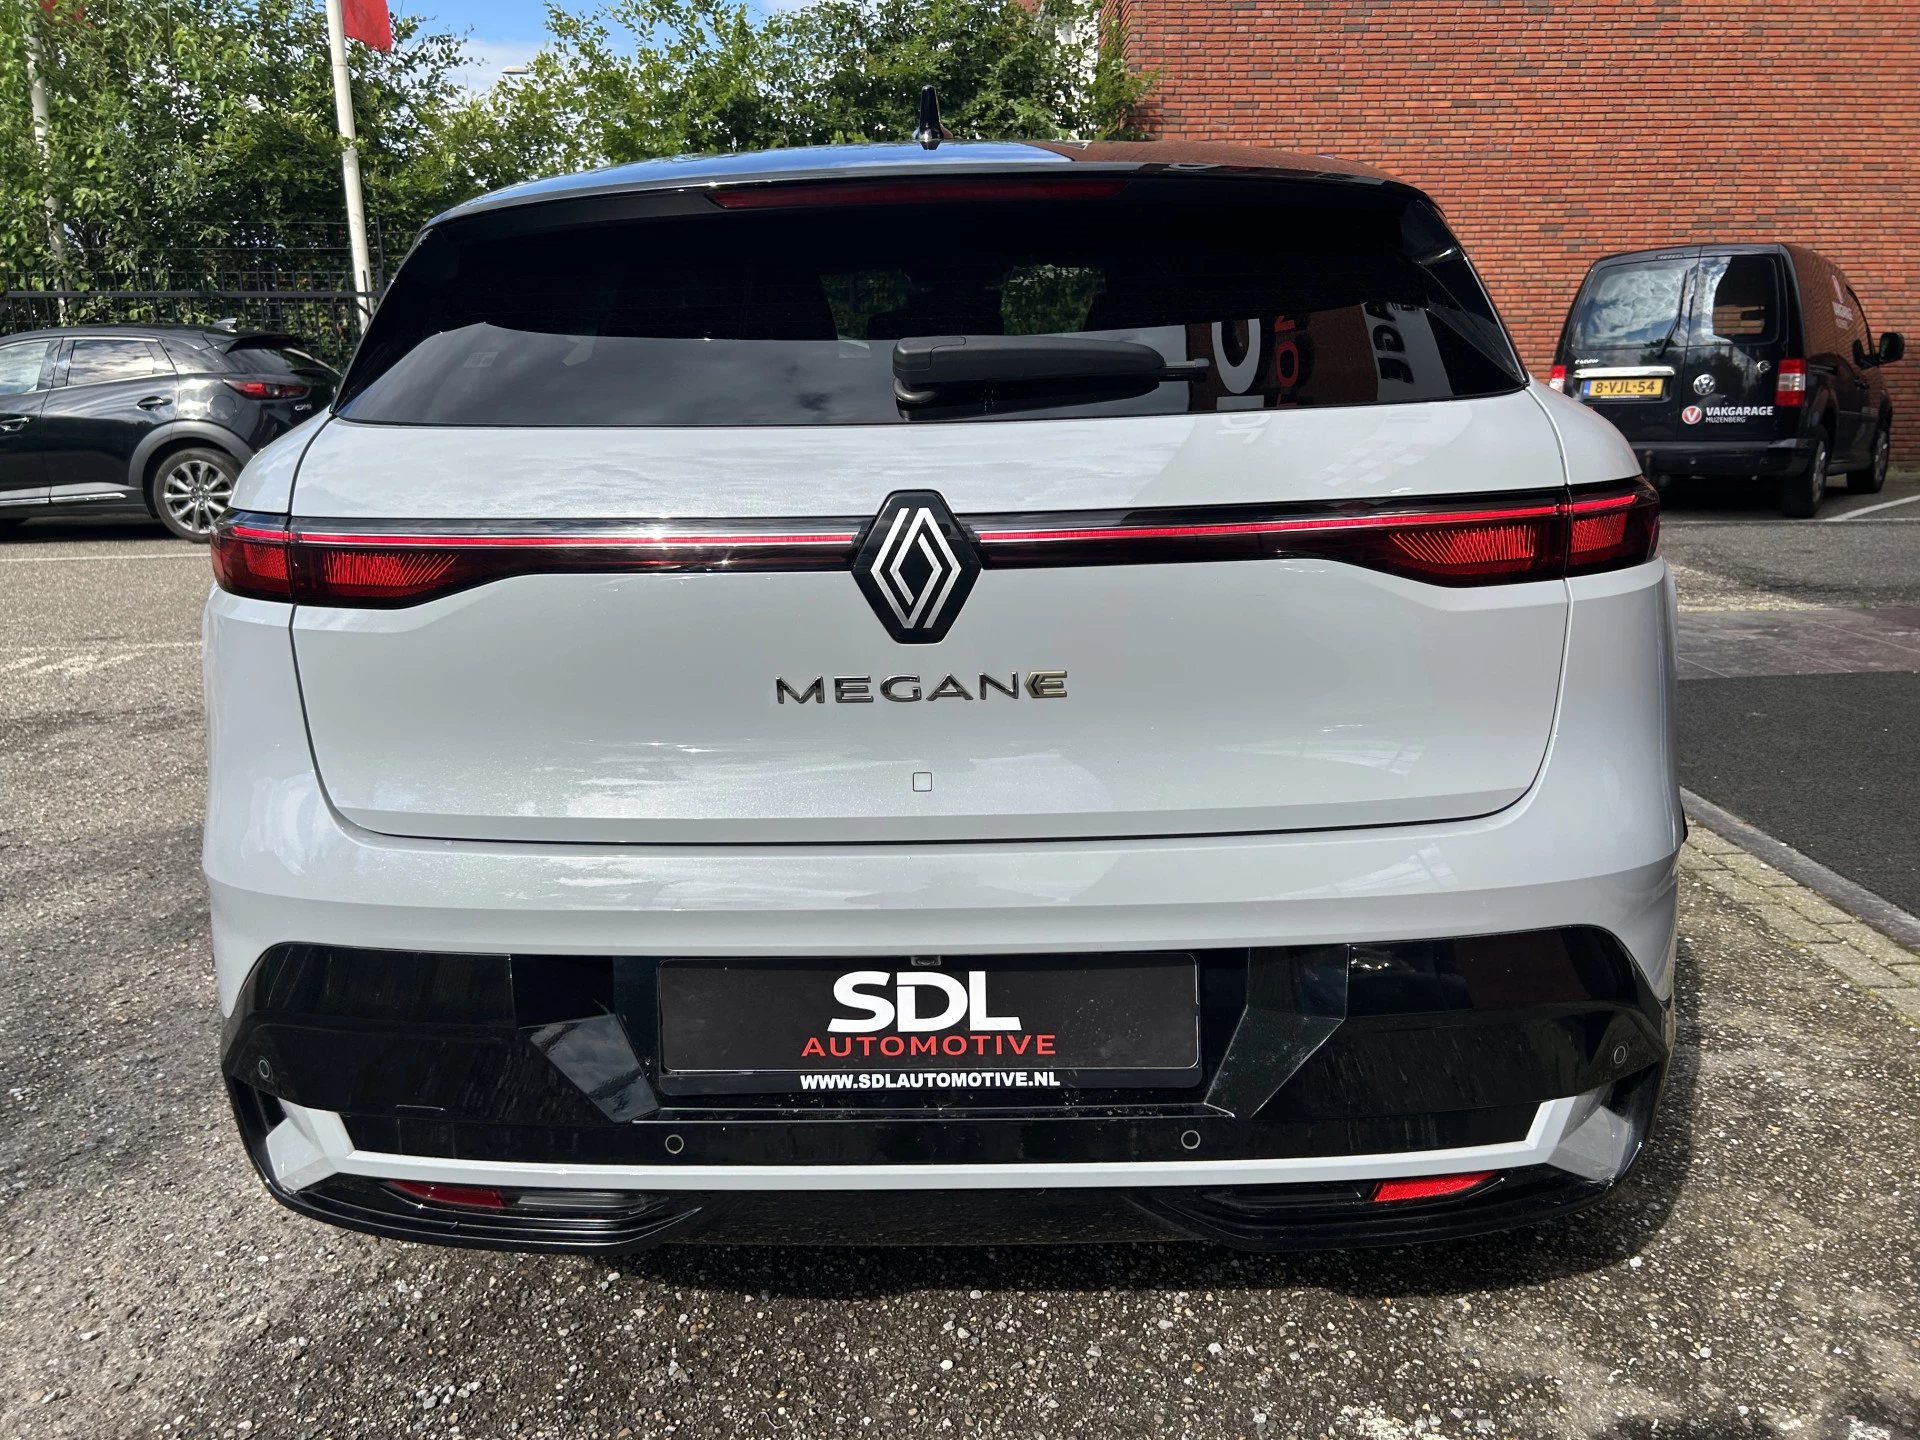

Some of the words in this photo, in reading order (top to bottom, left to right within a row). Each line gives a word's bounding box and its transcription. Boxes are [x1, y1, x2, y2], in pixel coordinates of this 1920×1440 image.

[1595, 381, 1655, 393] 8-VJL-54
[1706, 406, 1774, 416] VAKGARAGE
[775, 670, 1067, 704] MEGANE
[827, 971, 1022, 1032] SDL
[801, 1035, 1056, 1057] AUTOMOTIVE
[799, 1073, 1061, 1090] WWW.SDLAUTOMOTIVE.NL
